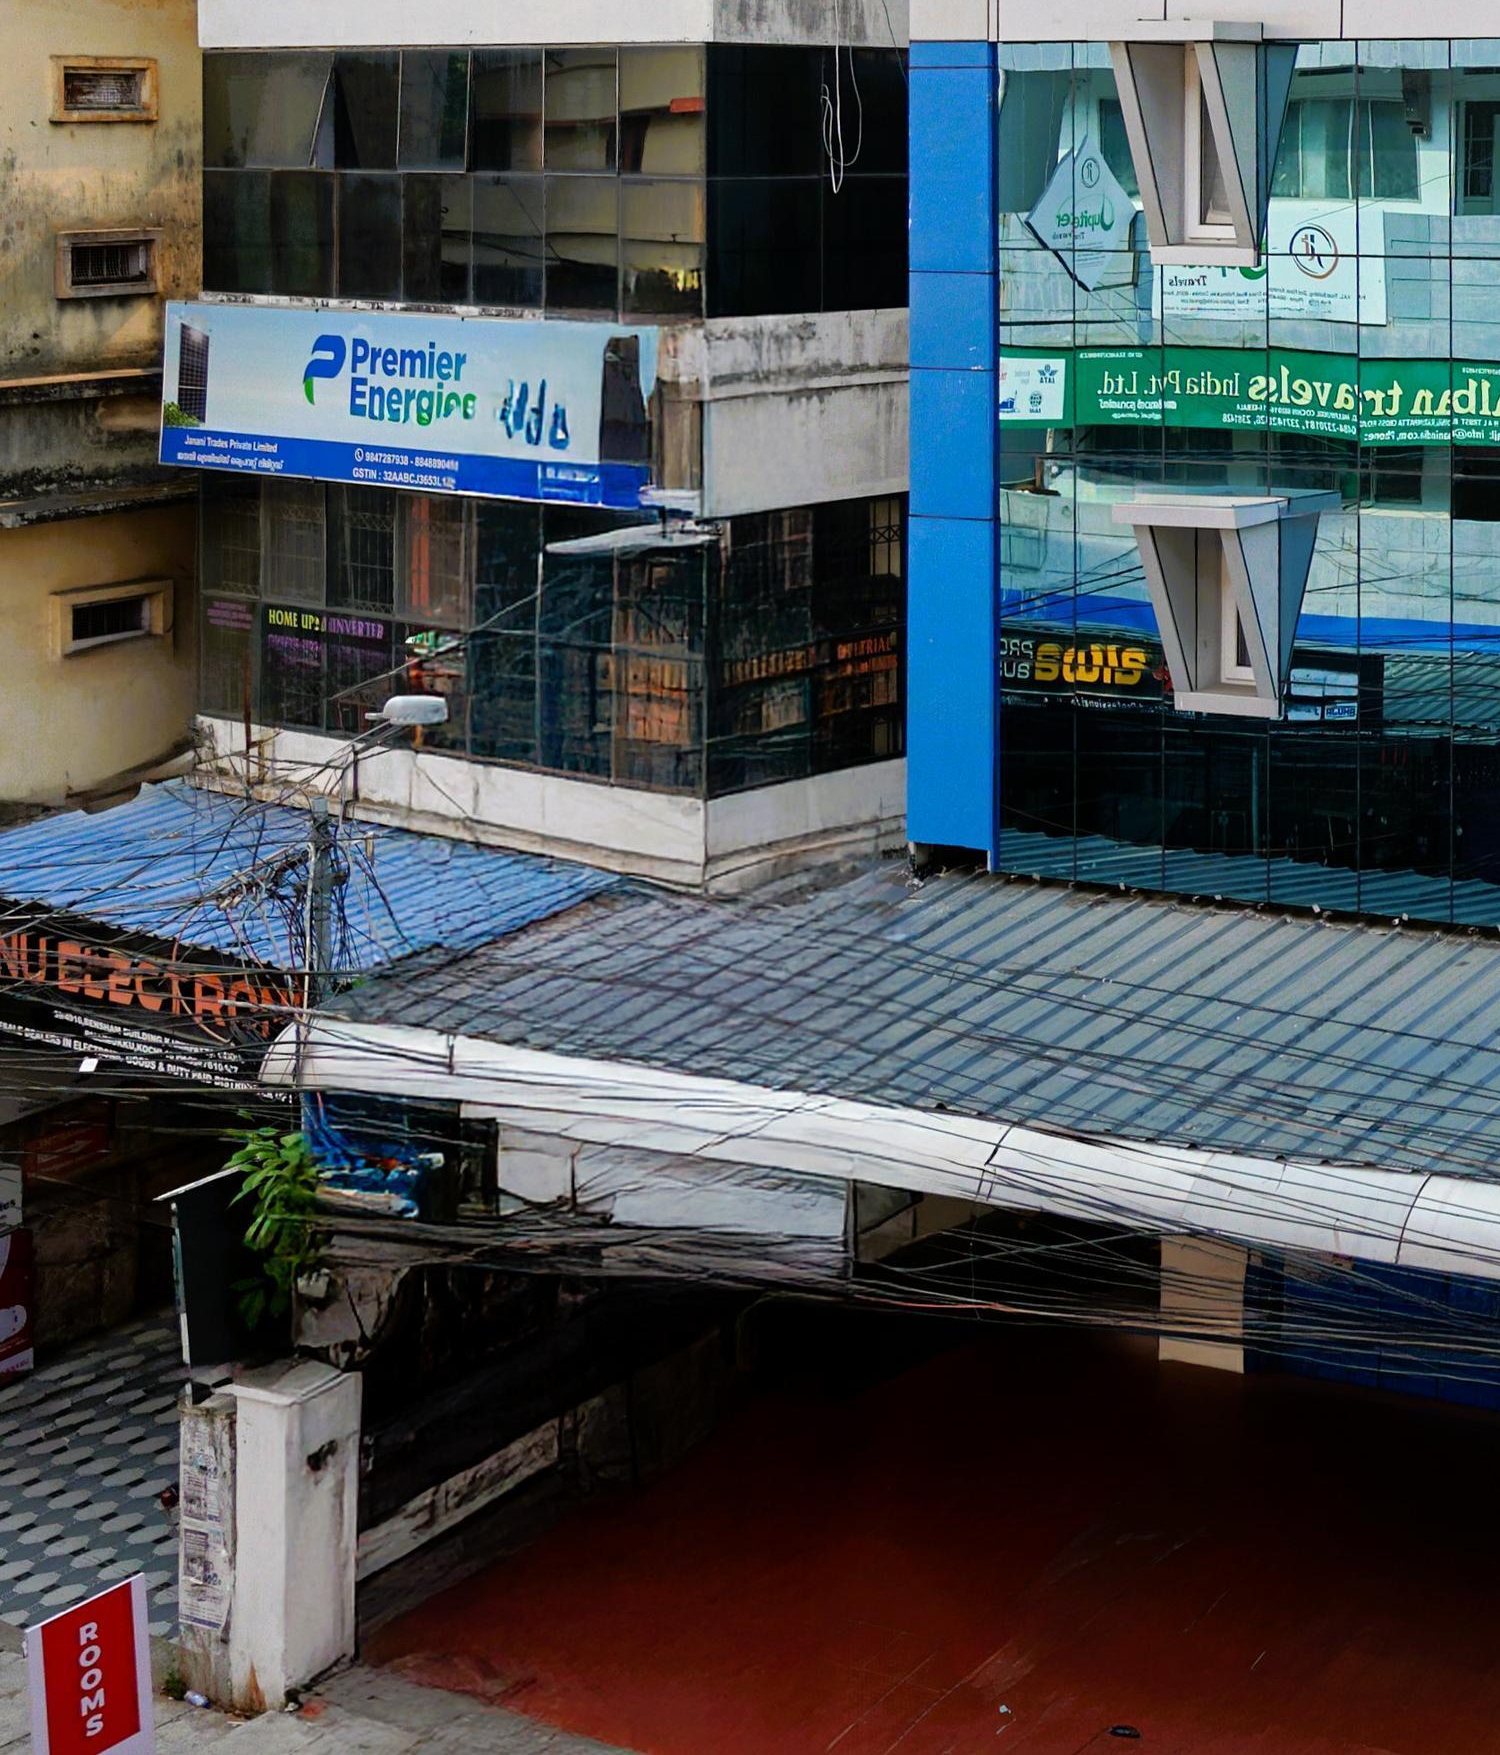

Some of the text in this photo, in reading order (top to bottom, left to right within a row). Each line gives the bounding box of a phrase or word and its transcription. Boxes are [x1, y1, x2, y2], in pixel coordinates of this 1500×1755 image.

[351, 337, 467, 381] Premier
[253, 441, 278, 453] Limited
[353, 467, 377, 479] GSTIN
[268, 608, 298, 628] HOME
[62, 1037, 72, 1048] IN
[126, 1056, 156, 1070] GOODS
[158, 1062, 165, 1072] &
[167, 1064, 190, 1079] DUTY
[192, 1072, 212, 1084] PAID
[79, 1622, 105, 1737] ROOMS
